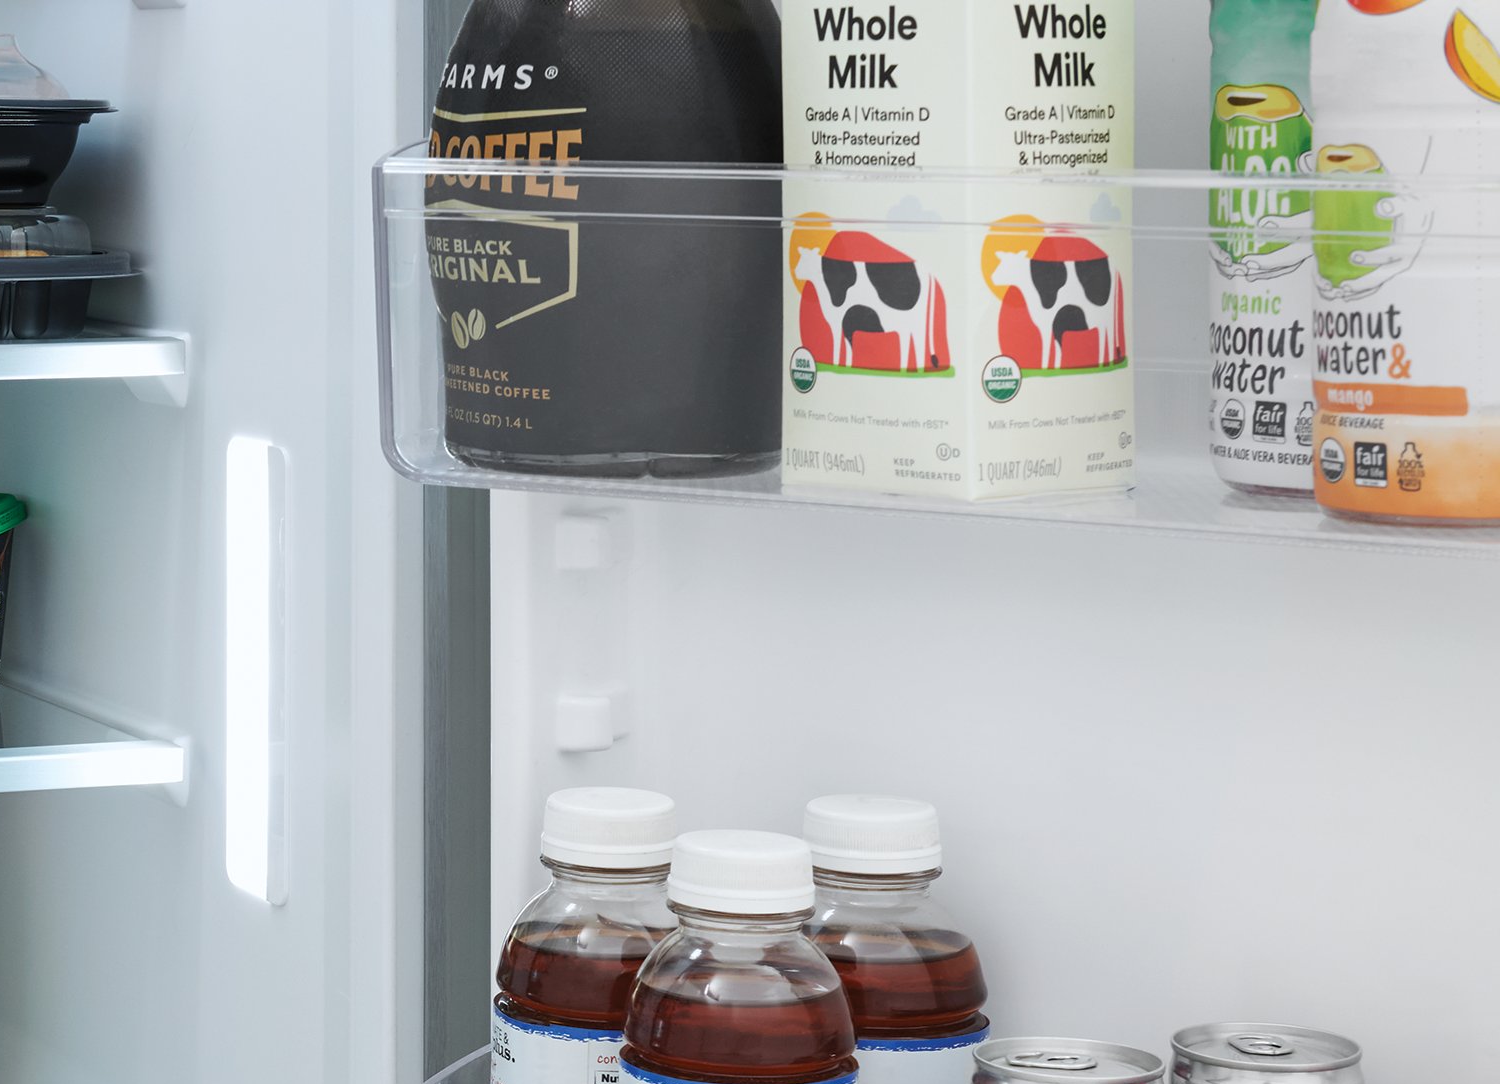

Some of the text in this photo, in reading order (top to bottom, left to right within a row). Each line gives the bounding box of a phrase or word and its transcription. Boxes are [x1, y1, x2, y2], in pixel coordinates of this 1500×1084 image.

[813, 5, 918, 42] Whole
[1015, 4, 1107, 39] Whole
[827, 54, 899, 89] Milk
[1033, 52, 1096, 87] Milk
[805, 106, 930, 122] Grade Vitamin D
[1004, 105, 1116, 121] Grade Vitamin D
[811, 130, 921, 146] Ultra-Pasteurized
[1013, 129, 1111, 146] Ultra-Pasteurized
[1226, 123, 1277, 150] WITH
[442, 128, 583, 200] COFFEE
[1032, 149, 1109, 168] Homogenized
[453, 238, 513, 256] BLACK
[1220, 288, 1283, 322] organic
[1313, 303, 1403, 340] coconut
[1209, 319, 1305, 358] coconut
[795, 357, 812, 370] USDA
[1316, 342, 1413, 380] water &
[469, 366, 510, 383] BLACK
[991, 366, 1014, 378] USDA
[1211, 358, 1286, 395] water
[494, 385, 551, 401] COFFEE
[1327, 386, 1375, 412] mango
[505, 415, 522, 430] 1.4
[867, 415, 900, 428] Treated
[1255, 405, 1285, 423] fair
[1339, 415, 1386, 430] BEVERAGE
[1009, 417, 1054, 430] From Cows
[791, 449, 865, 476] QUART (946mL)
[893, 457, 915, 467] KEEP
[1086, 459, 1134, 472] REFRIGERATED
[1252, 450, 1275, 463] VERA
[1355, 447, 1385, 467] fair
[894, 469, 962, 482] REFRIGERATED
[987, 456, 1062, 481] QUART (946mL)
